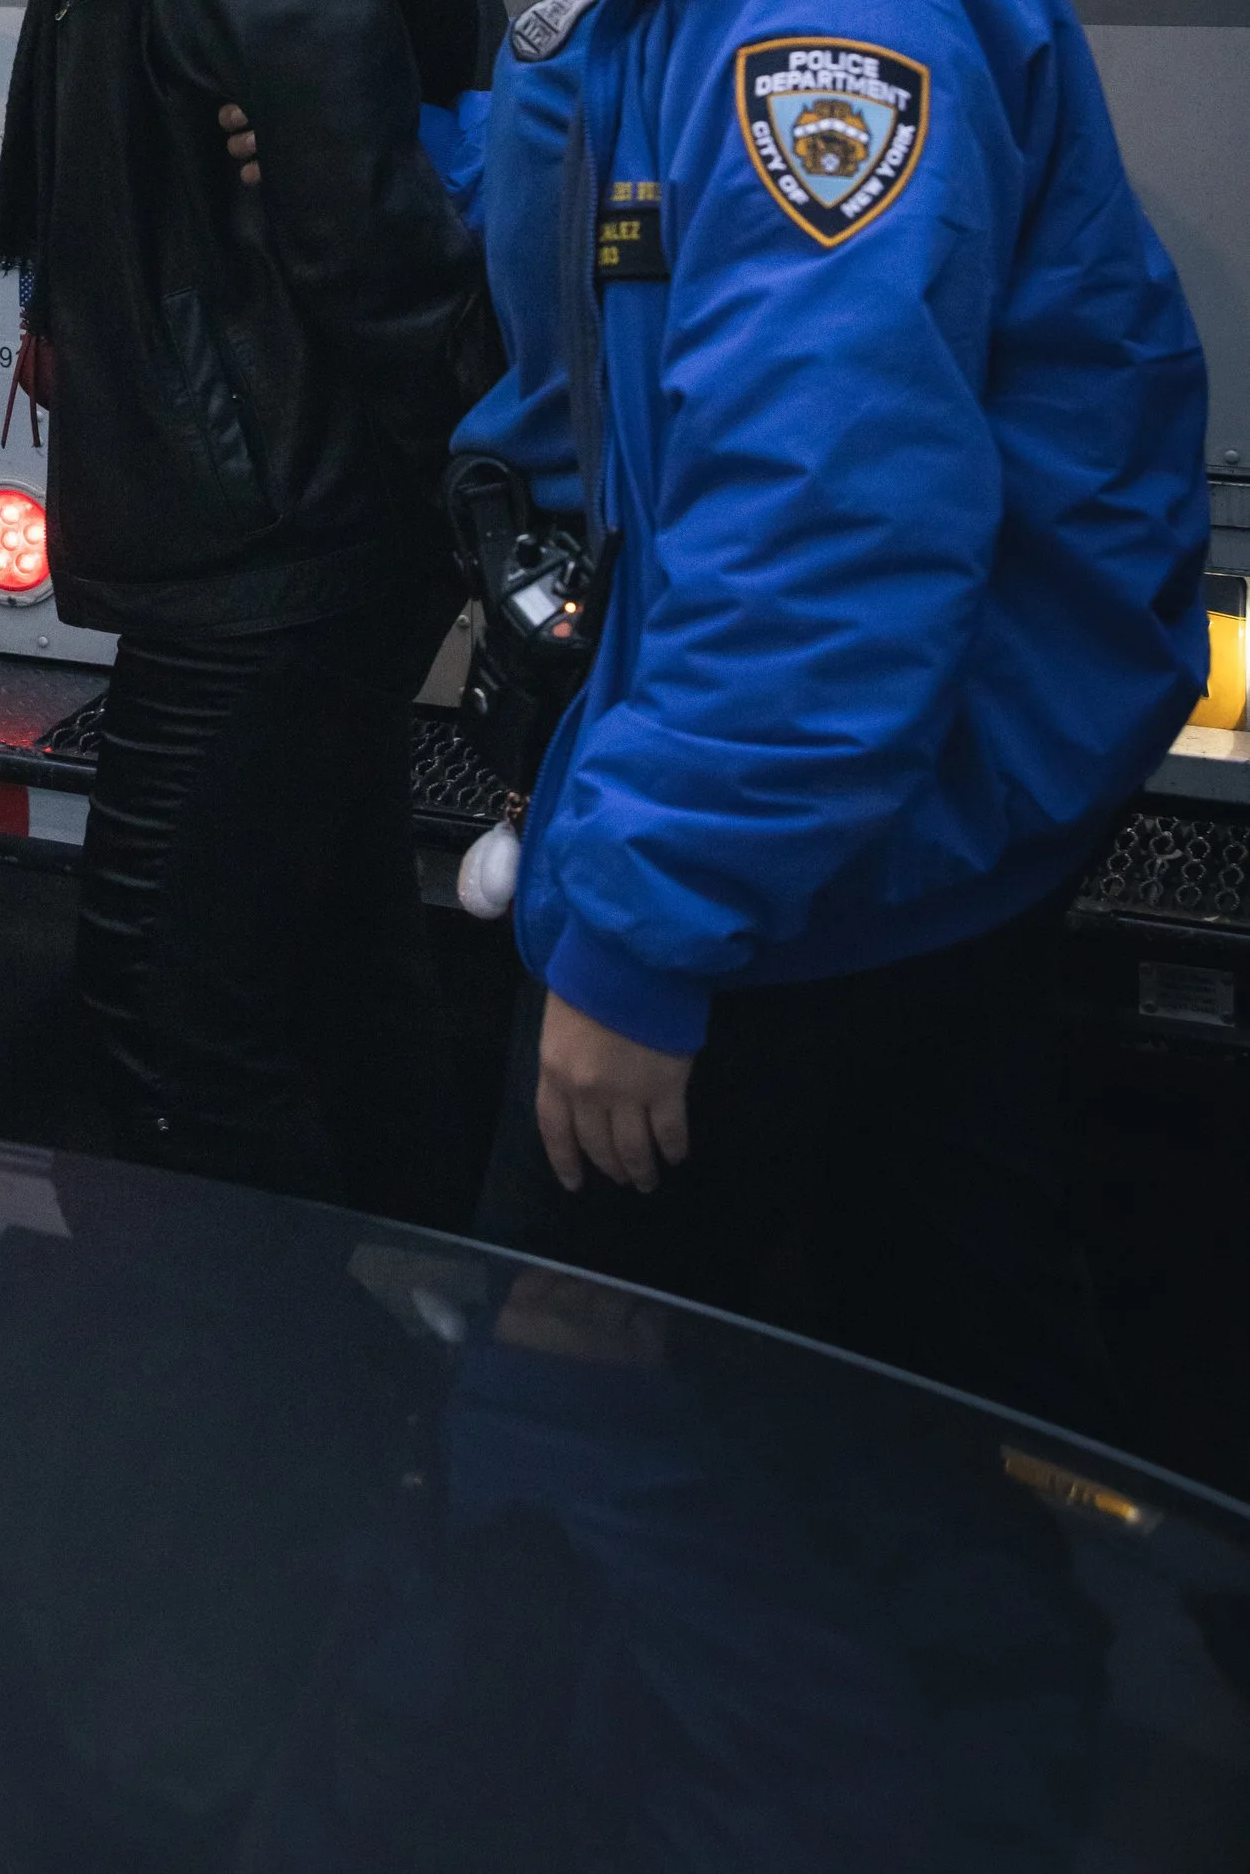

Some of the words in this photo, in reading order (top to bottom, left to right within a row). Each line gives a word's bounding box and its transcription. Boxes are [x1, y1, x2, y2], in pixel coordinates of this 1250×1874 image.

[787, 49, 880, 79] POLICE
[754, 69, 912, 112] DEPARTMENT
[751, 120, 788, 172] CITY
[777, 174, 810, 206] OF
[839, 176, 885, 219] NEW
[875, 123, 916, 178] YORK
